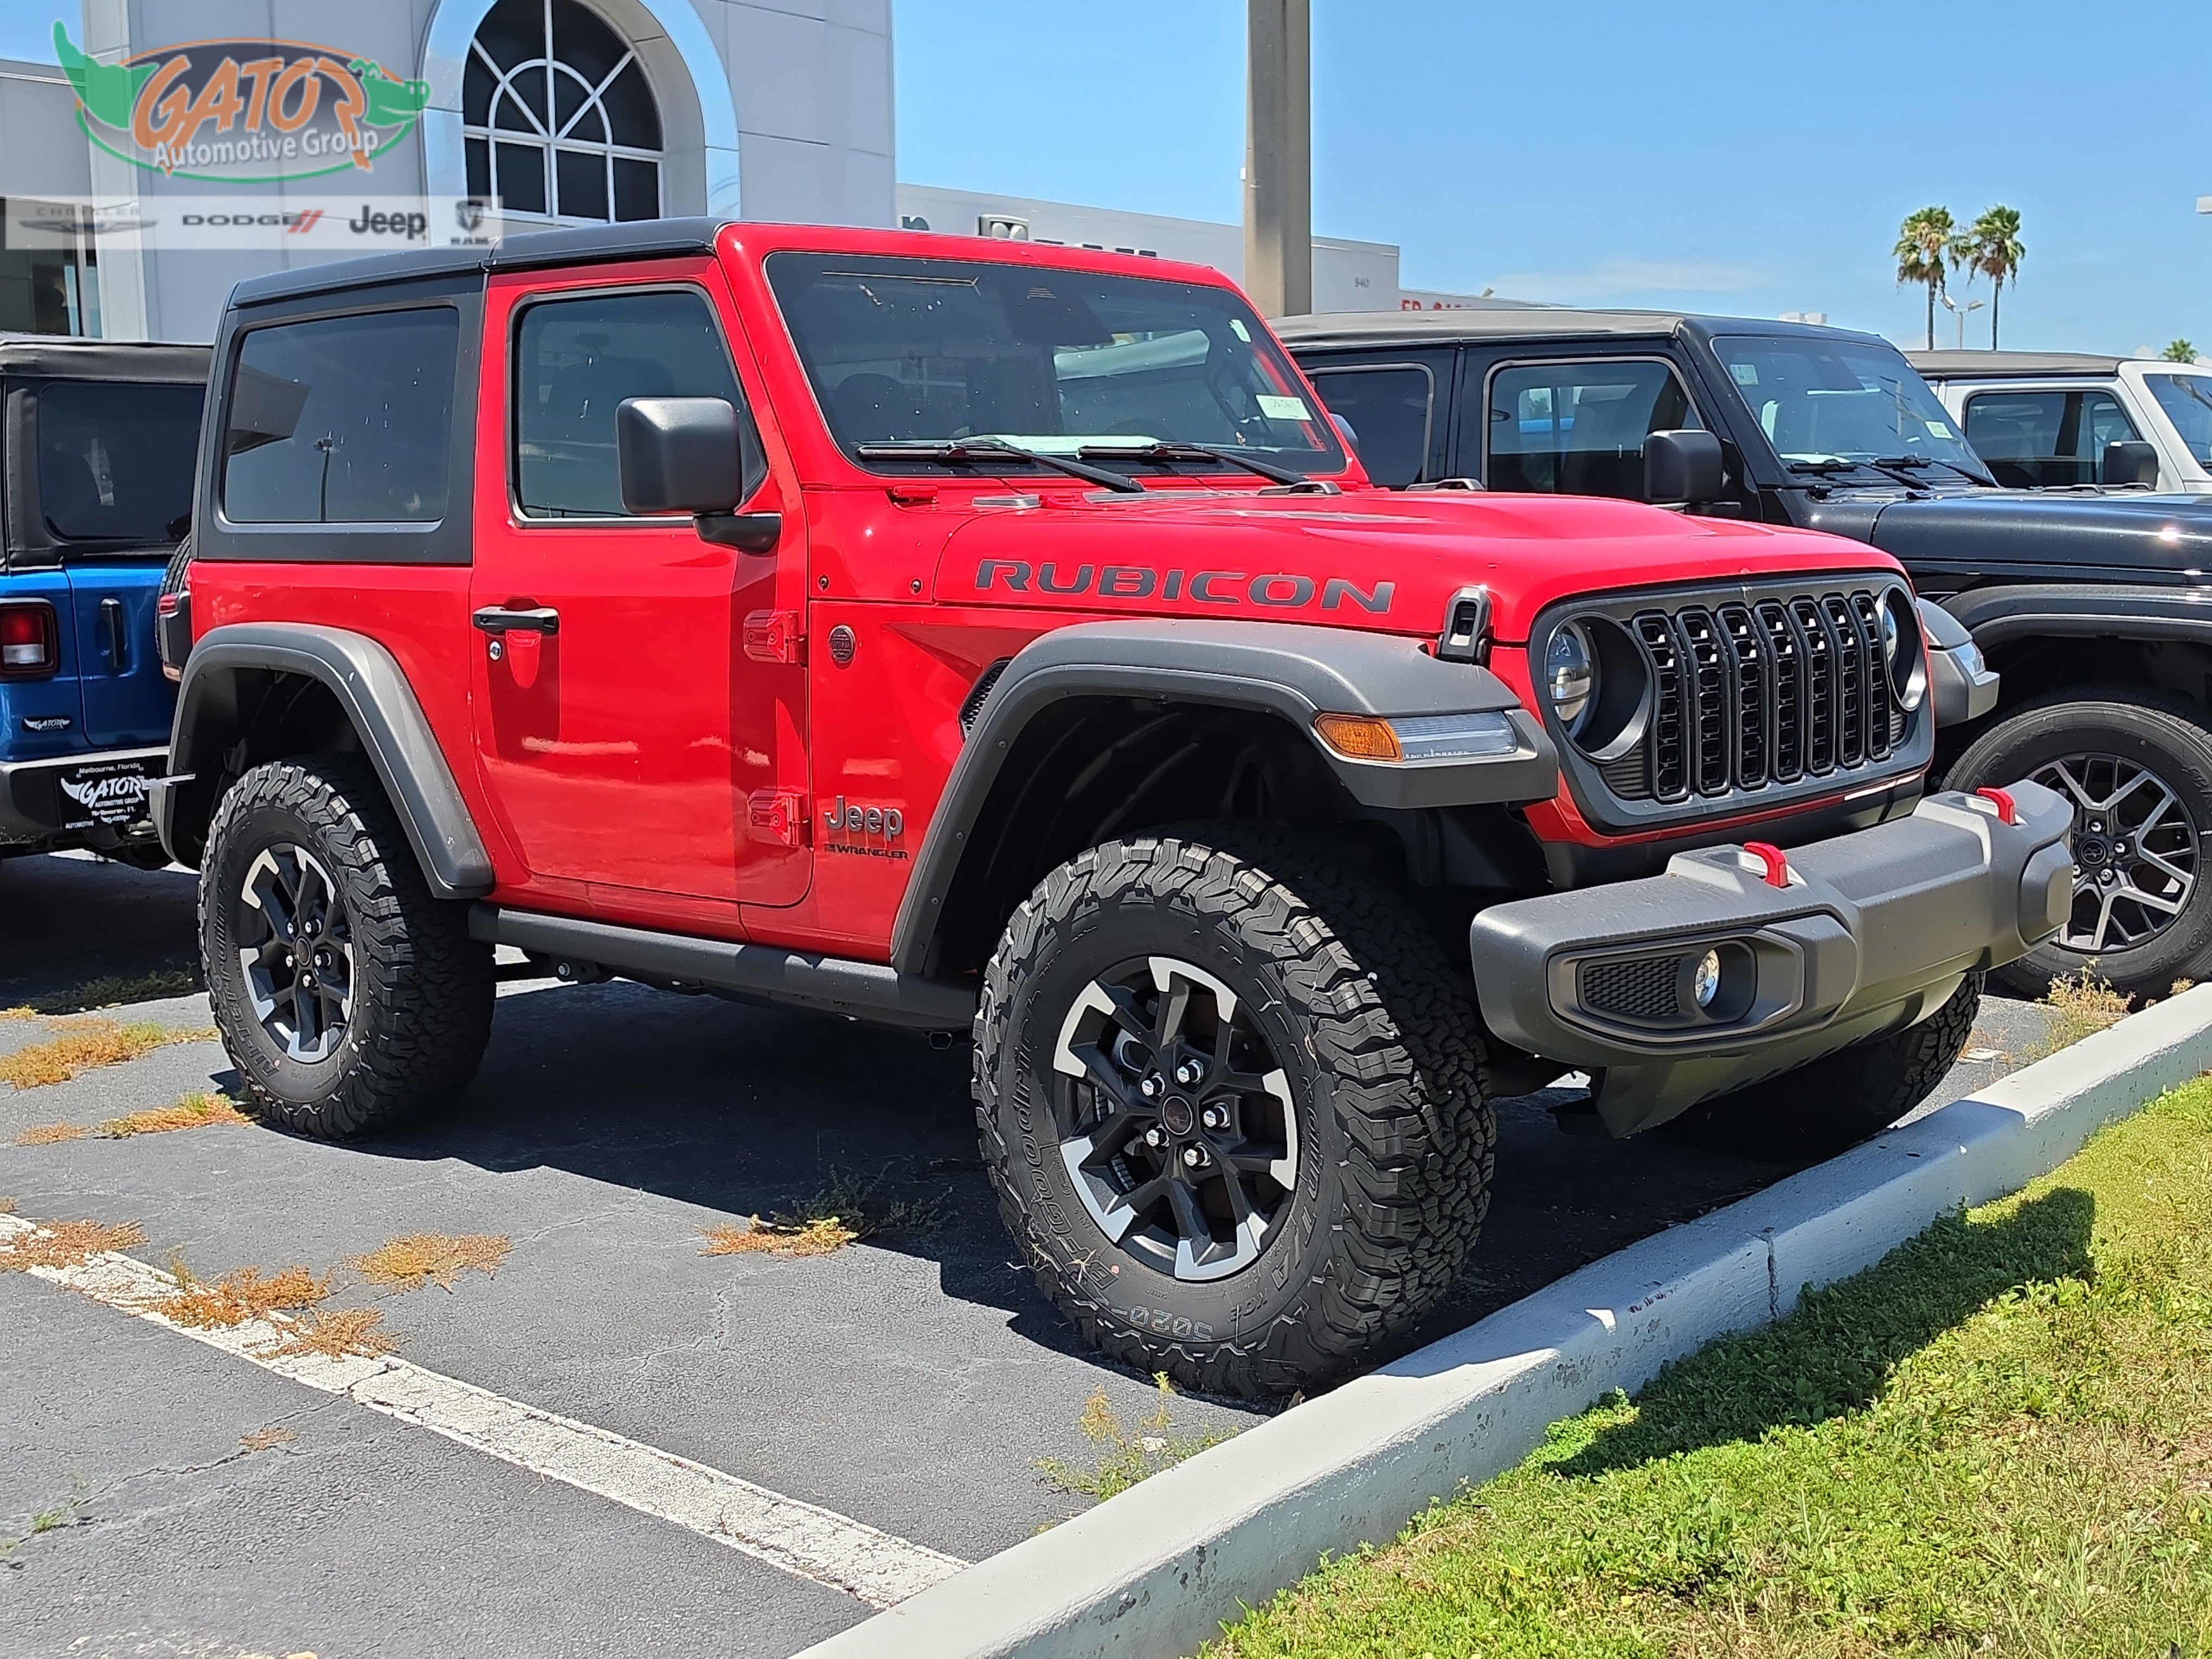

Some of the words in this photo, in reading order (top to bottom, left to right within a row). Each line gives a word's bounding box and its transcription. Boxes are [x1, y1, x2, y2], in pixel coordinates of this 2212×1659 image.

[973, 558, 1397, 613] RUBICON
[80, 776, 145, 809] GATOR
[824, 795, 904, 841] Jeep
[836, 844, 910, 860] WRANGLER
